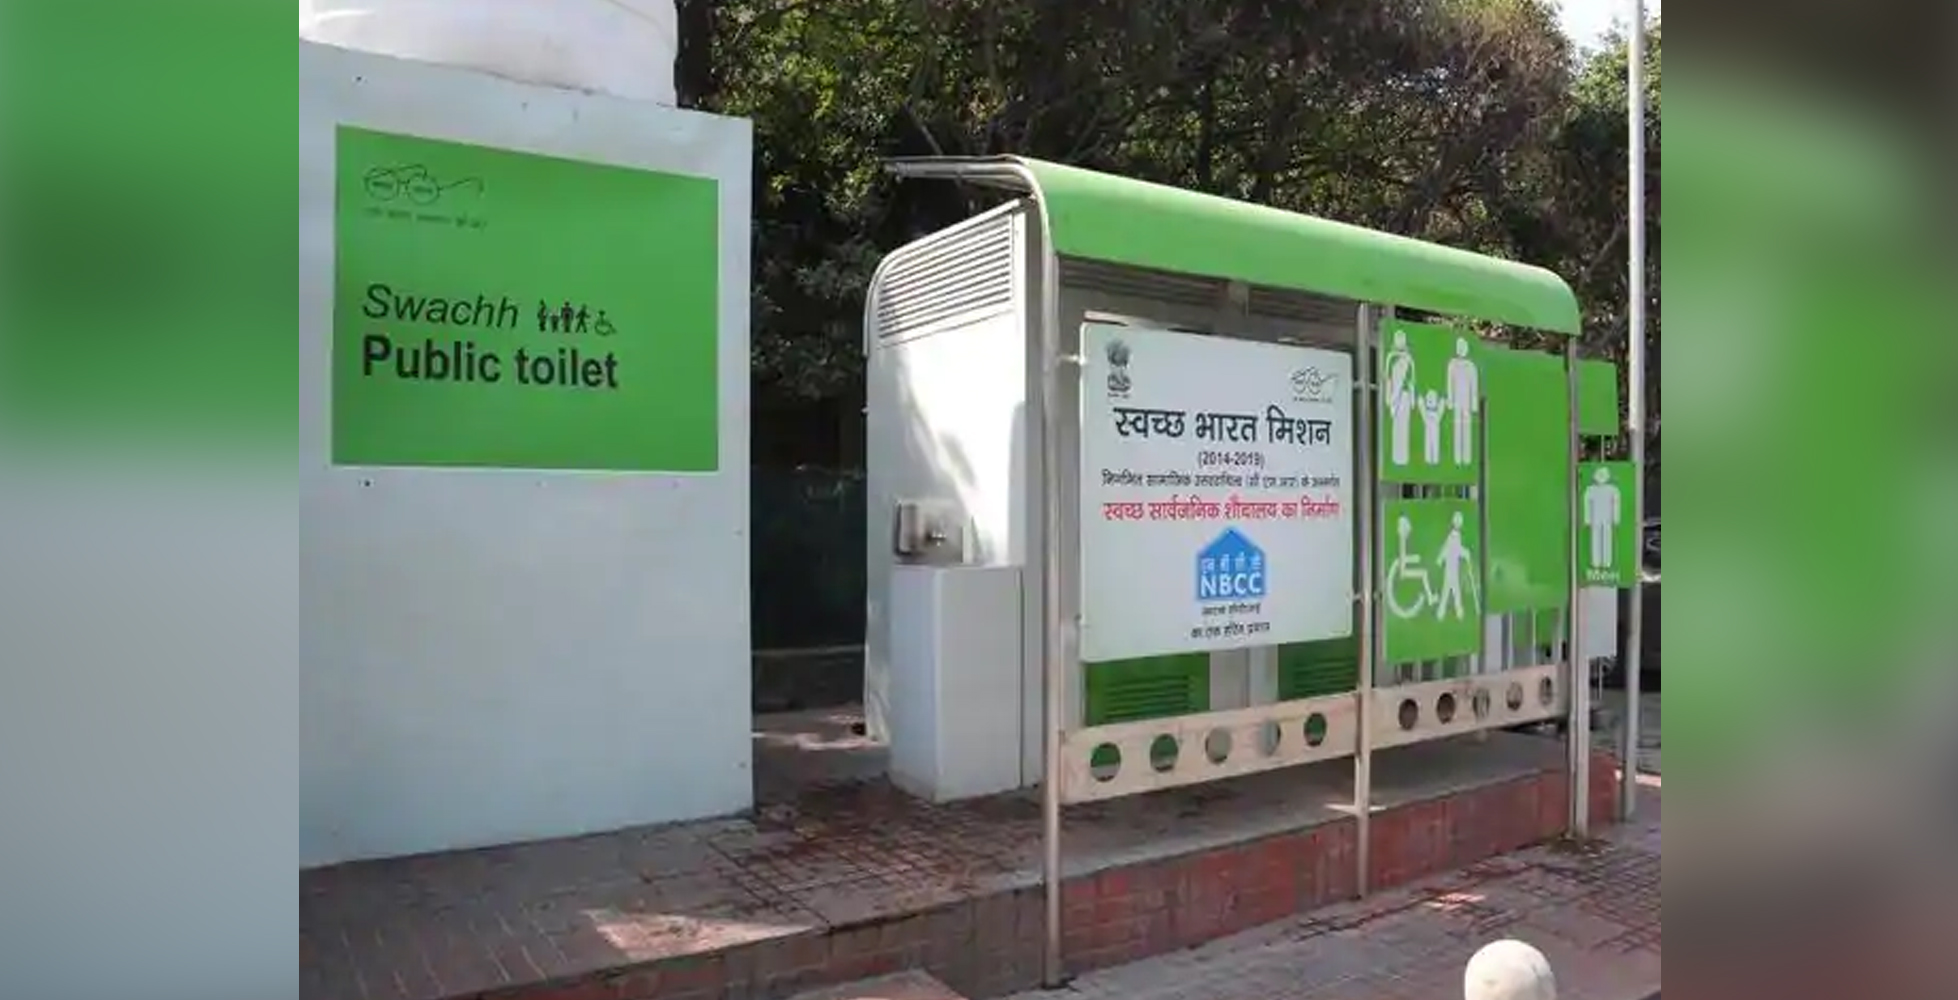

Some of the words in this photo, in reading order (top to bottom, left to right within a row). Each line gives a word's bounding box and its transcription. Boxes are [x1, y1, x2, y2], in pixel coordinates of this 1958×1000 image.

[363, 284, 519, 328] Swachh
[363, 334, 501, 382] Public
[515, 347, 618, 388] toilet
[1113, 407, 1186, 437] स्वच्छ
[1196, 412, 1259, 442] भारत
[1266, 404, 1332, 446] मिशन
[1198, 450, 1265, 469] (2014-2019)
[1102, 502, 1144, 520] स्वच्छ
[1147, 494, 1220, 520] सार्वजनिक
[1281, 502, 1298, 519] का
[1201, 572, 1262, 597] NBCC
